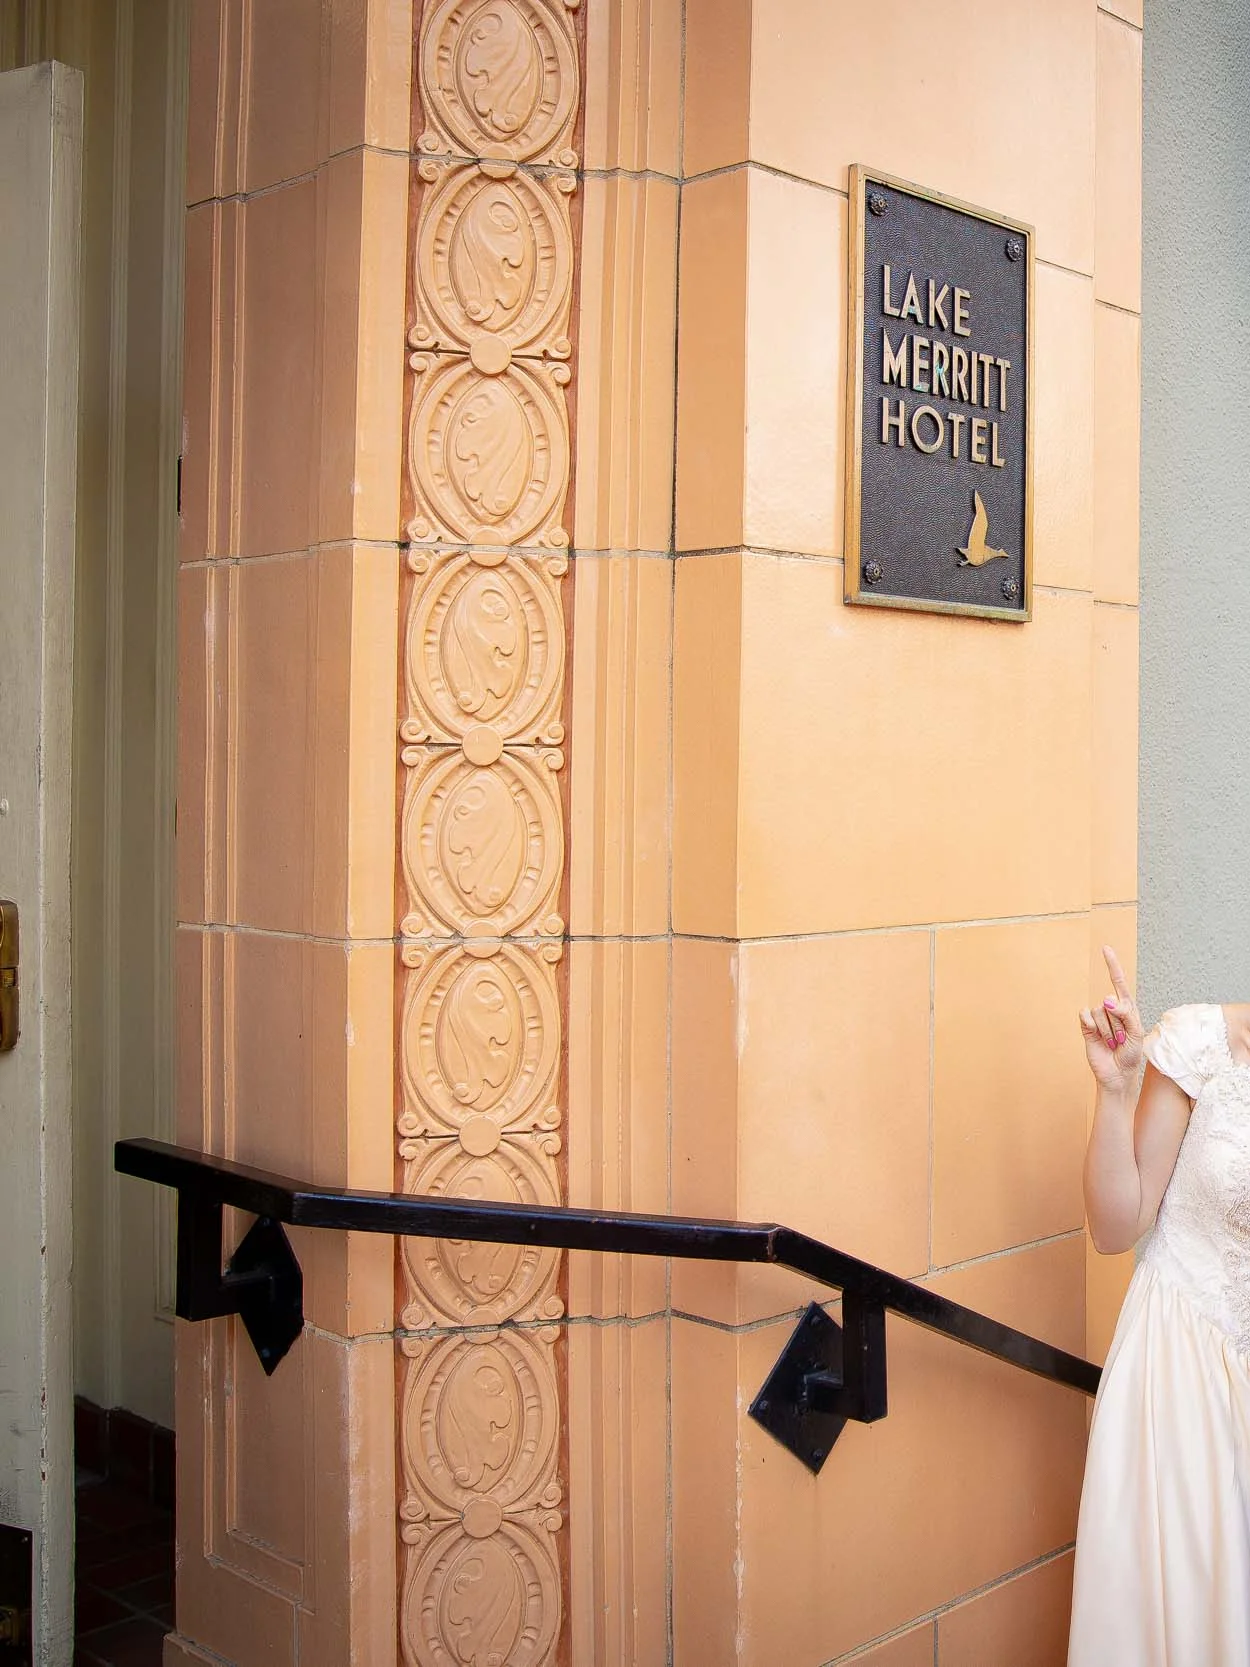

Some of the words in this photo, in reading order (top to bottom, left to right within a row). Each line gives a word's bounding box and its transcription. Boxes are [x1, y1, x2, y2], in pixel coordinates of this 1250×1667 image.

[882, 264, 972, 337] LAKE
[881, 327, 1011, 412] MERRITT
[880, 397, 1006, 468] HOTEL
